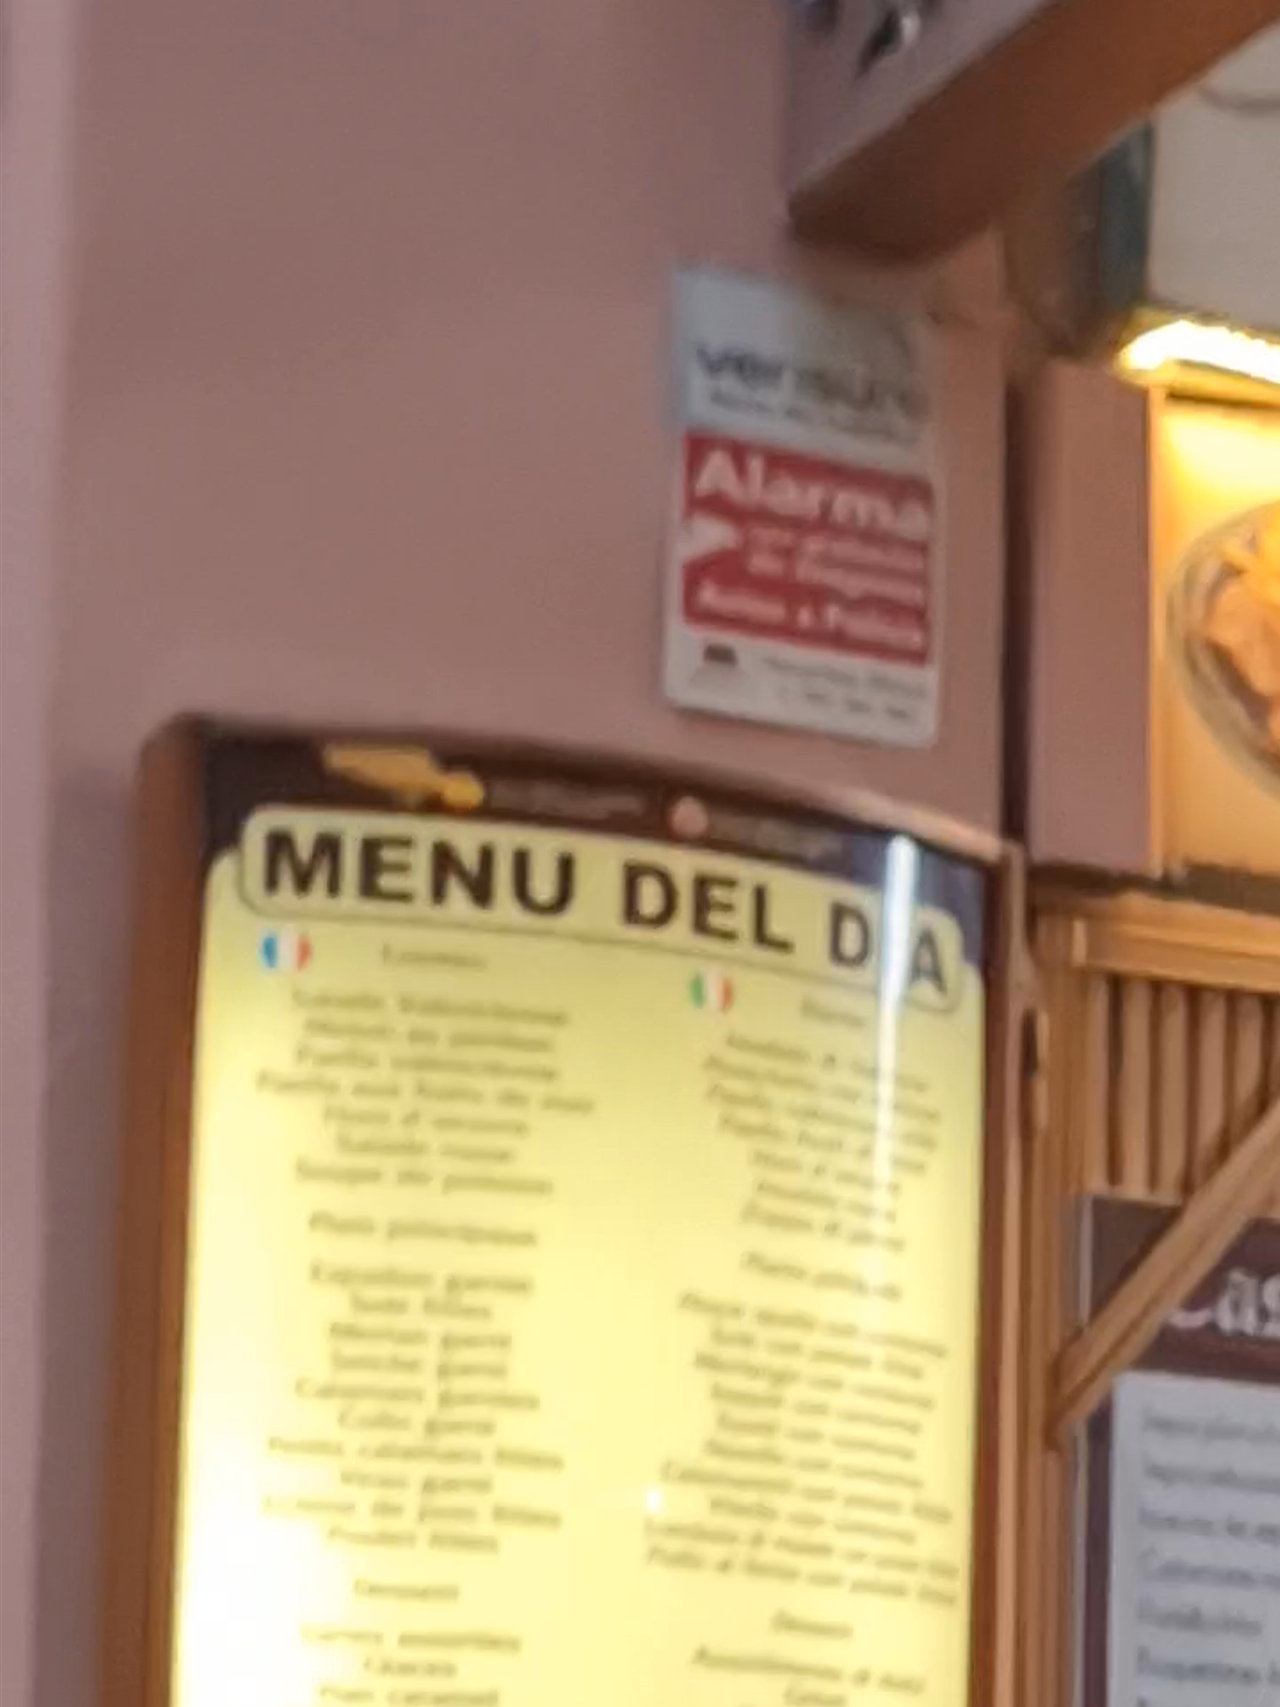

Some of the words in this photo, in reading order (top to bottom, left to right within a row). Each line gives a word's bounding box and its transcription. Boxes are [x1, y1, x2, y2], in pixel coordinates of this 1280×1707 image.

[695, 447, 930, 539] Alarma
[263, 828, 575, 918] MENU
[622, 860, 794, 955] DEL
[827, 901, 950, 997] DA
